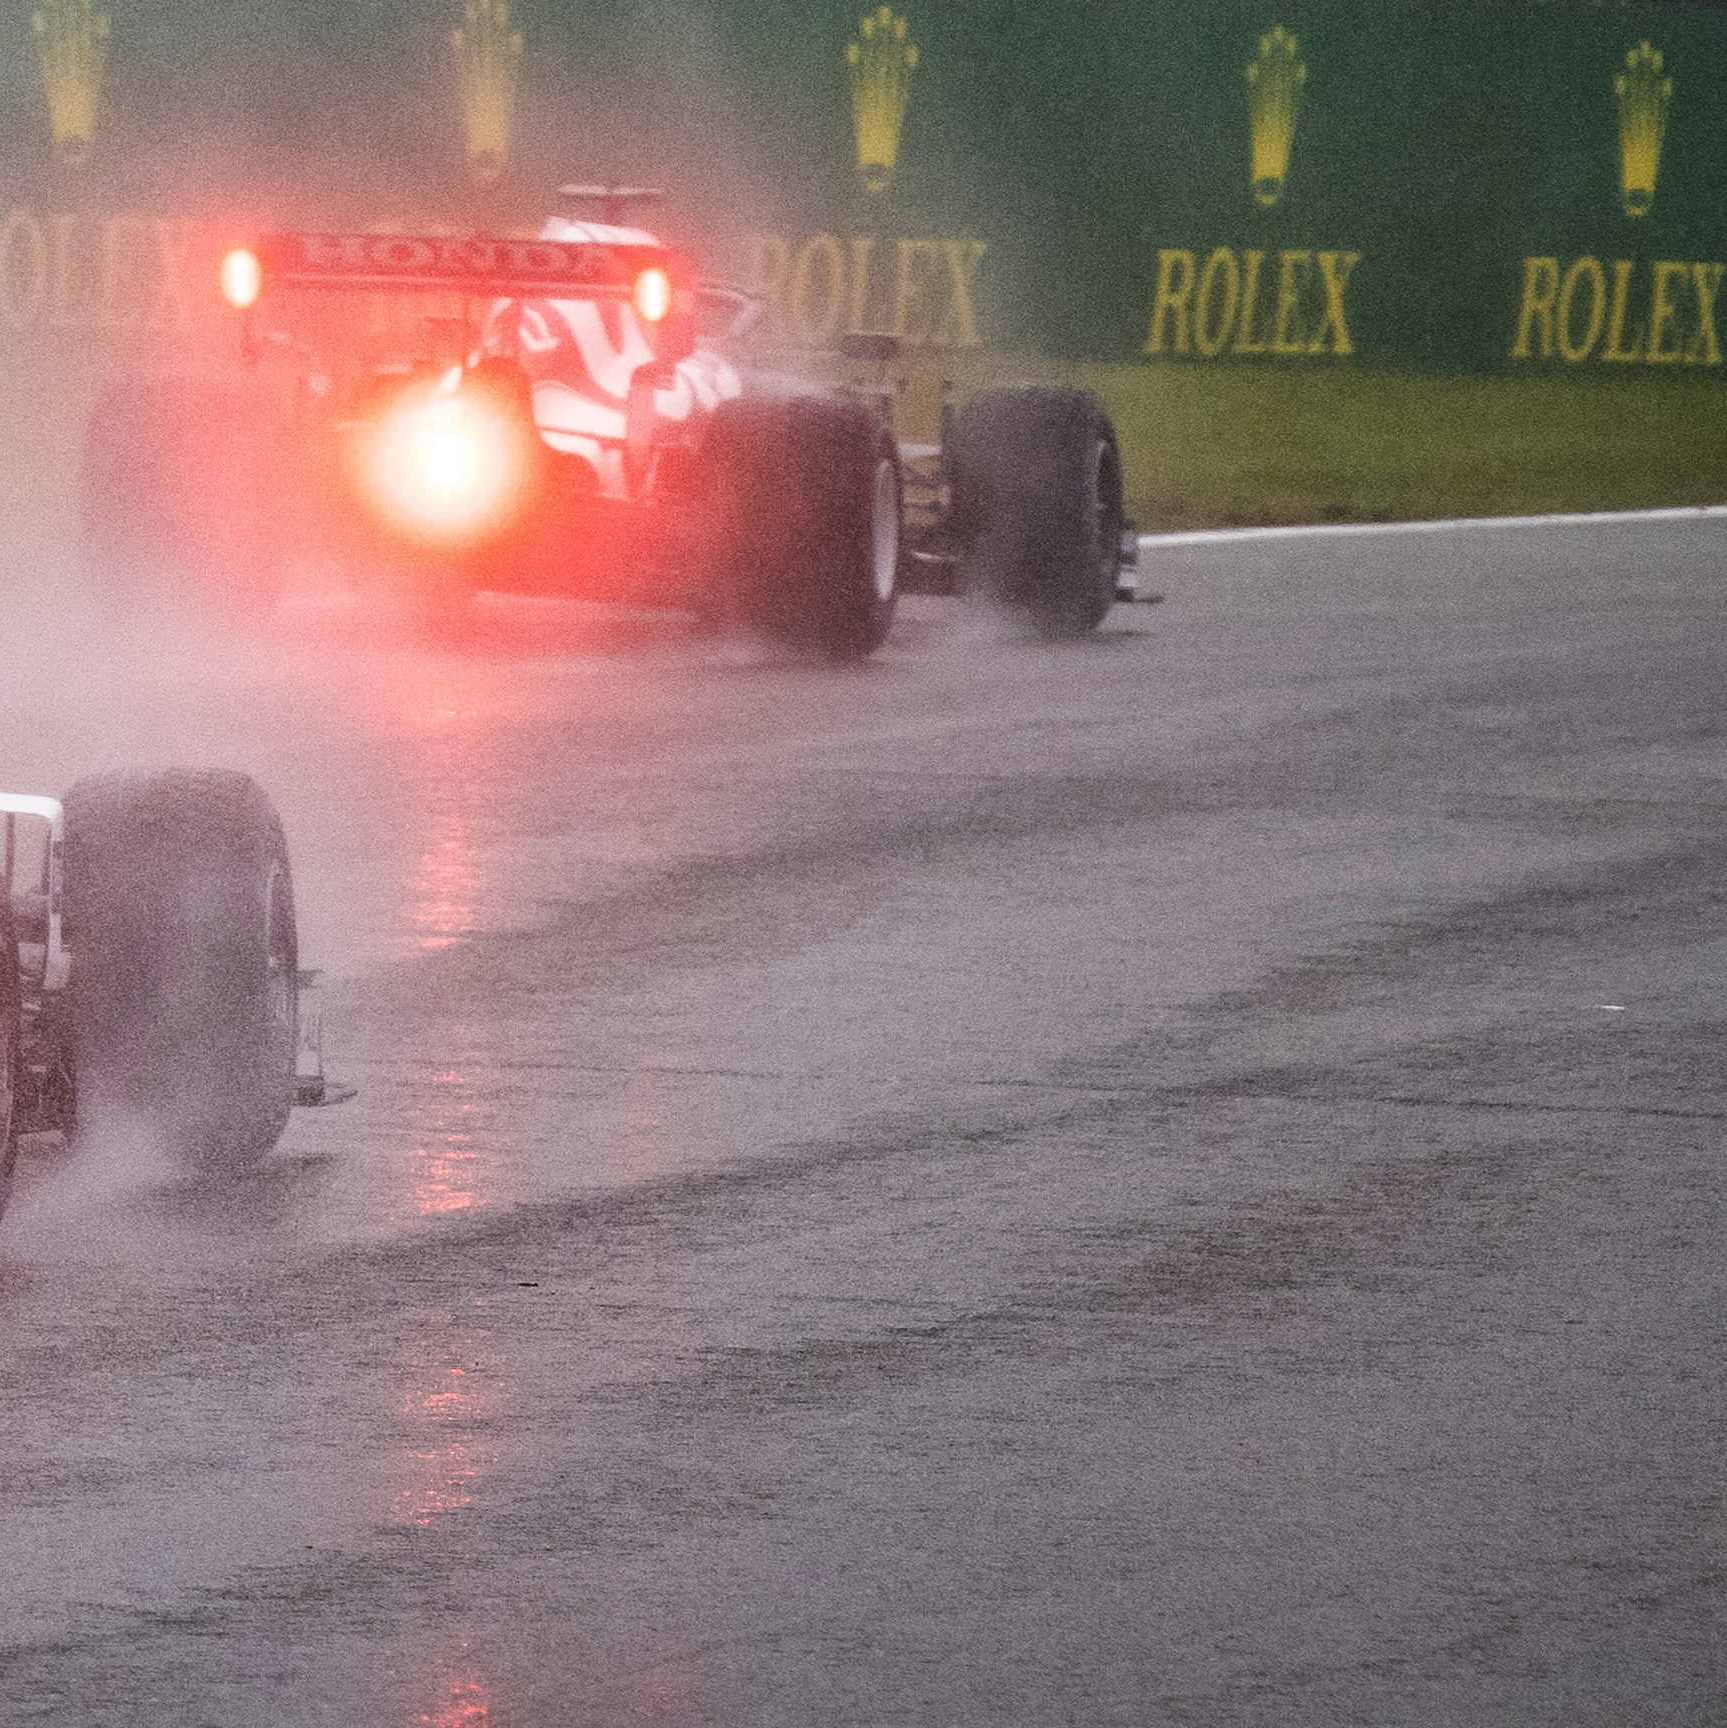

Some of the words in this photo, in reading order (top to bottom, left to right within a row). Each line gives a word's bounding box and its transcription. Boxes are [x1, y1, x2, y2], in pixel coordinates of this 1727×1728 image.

[300, 232, 630, 274] HONDA
[744, 229, 988, 348] ROLEX
[1143, 244, 1361, 356] ROLEX
[1511, 254, 1727, 364] ROLEX
